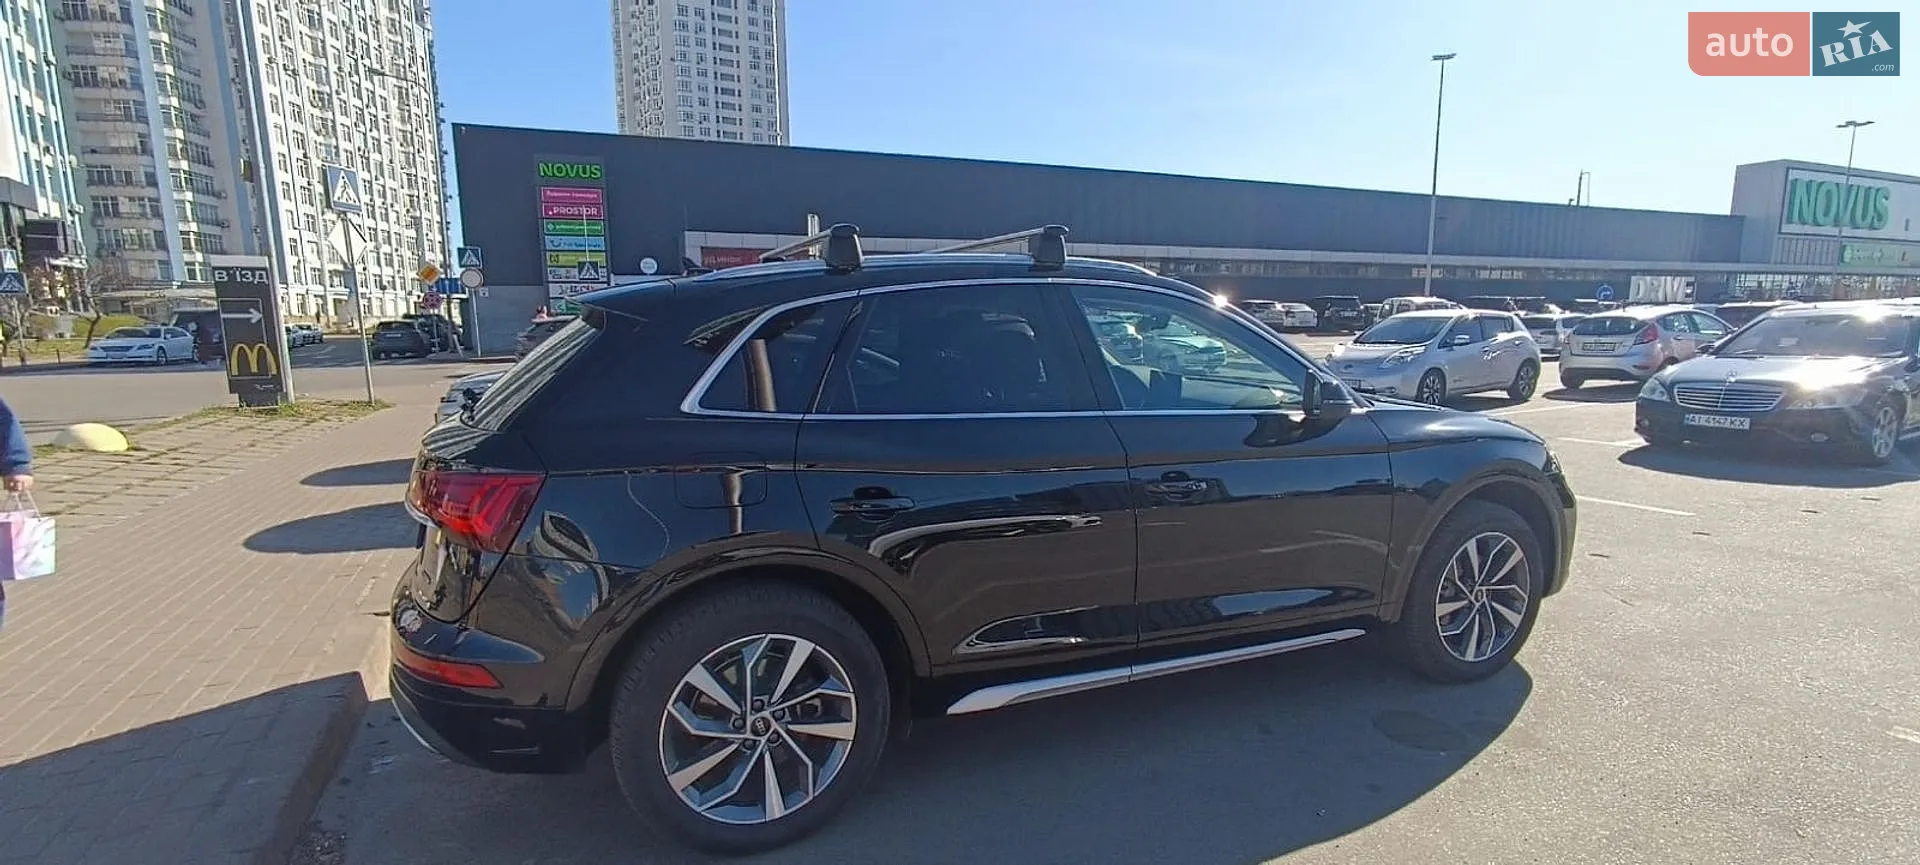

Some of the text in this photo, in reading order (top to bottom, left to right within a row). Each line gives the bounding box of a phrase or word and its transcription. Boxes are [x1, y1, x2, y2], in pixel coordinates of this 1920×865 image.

[538, 162, 602, 179] NOVUS
[553, 206, 598, 216] PROSTOR
[1789, 178, 1891, 230] NOVUS
[1629, 275, 1698, 304] DRIVE
